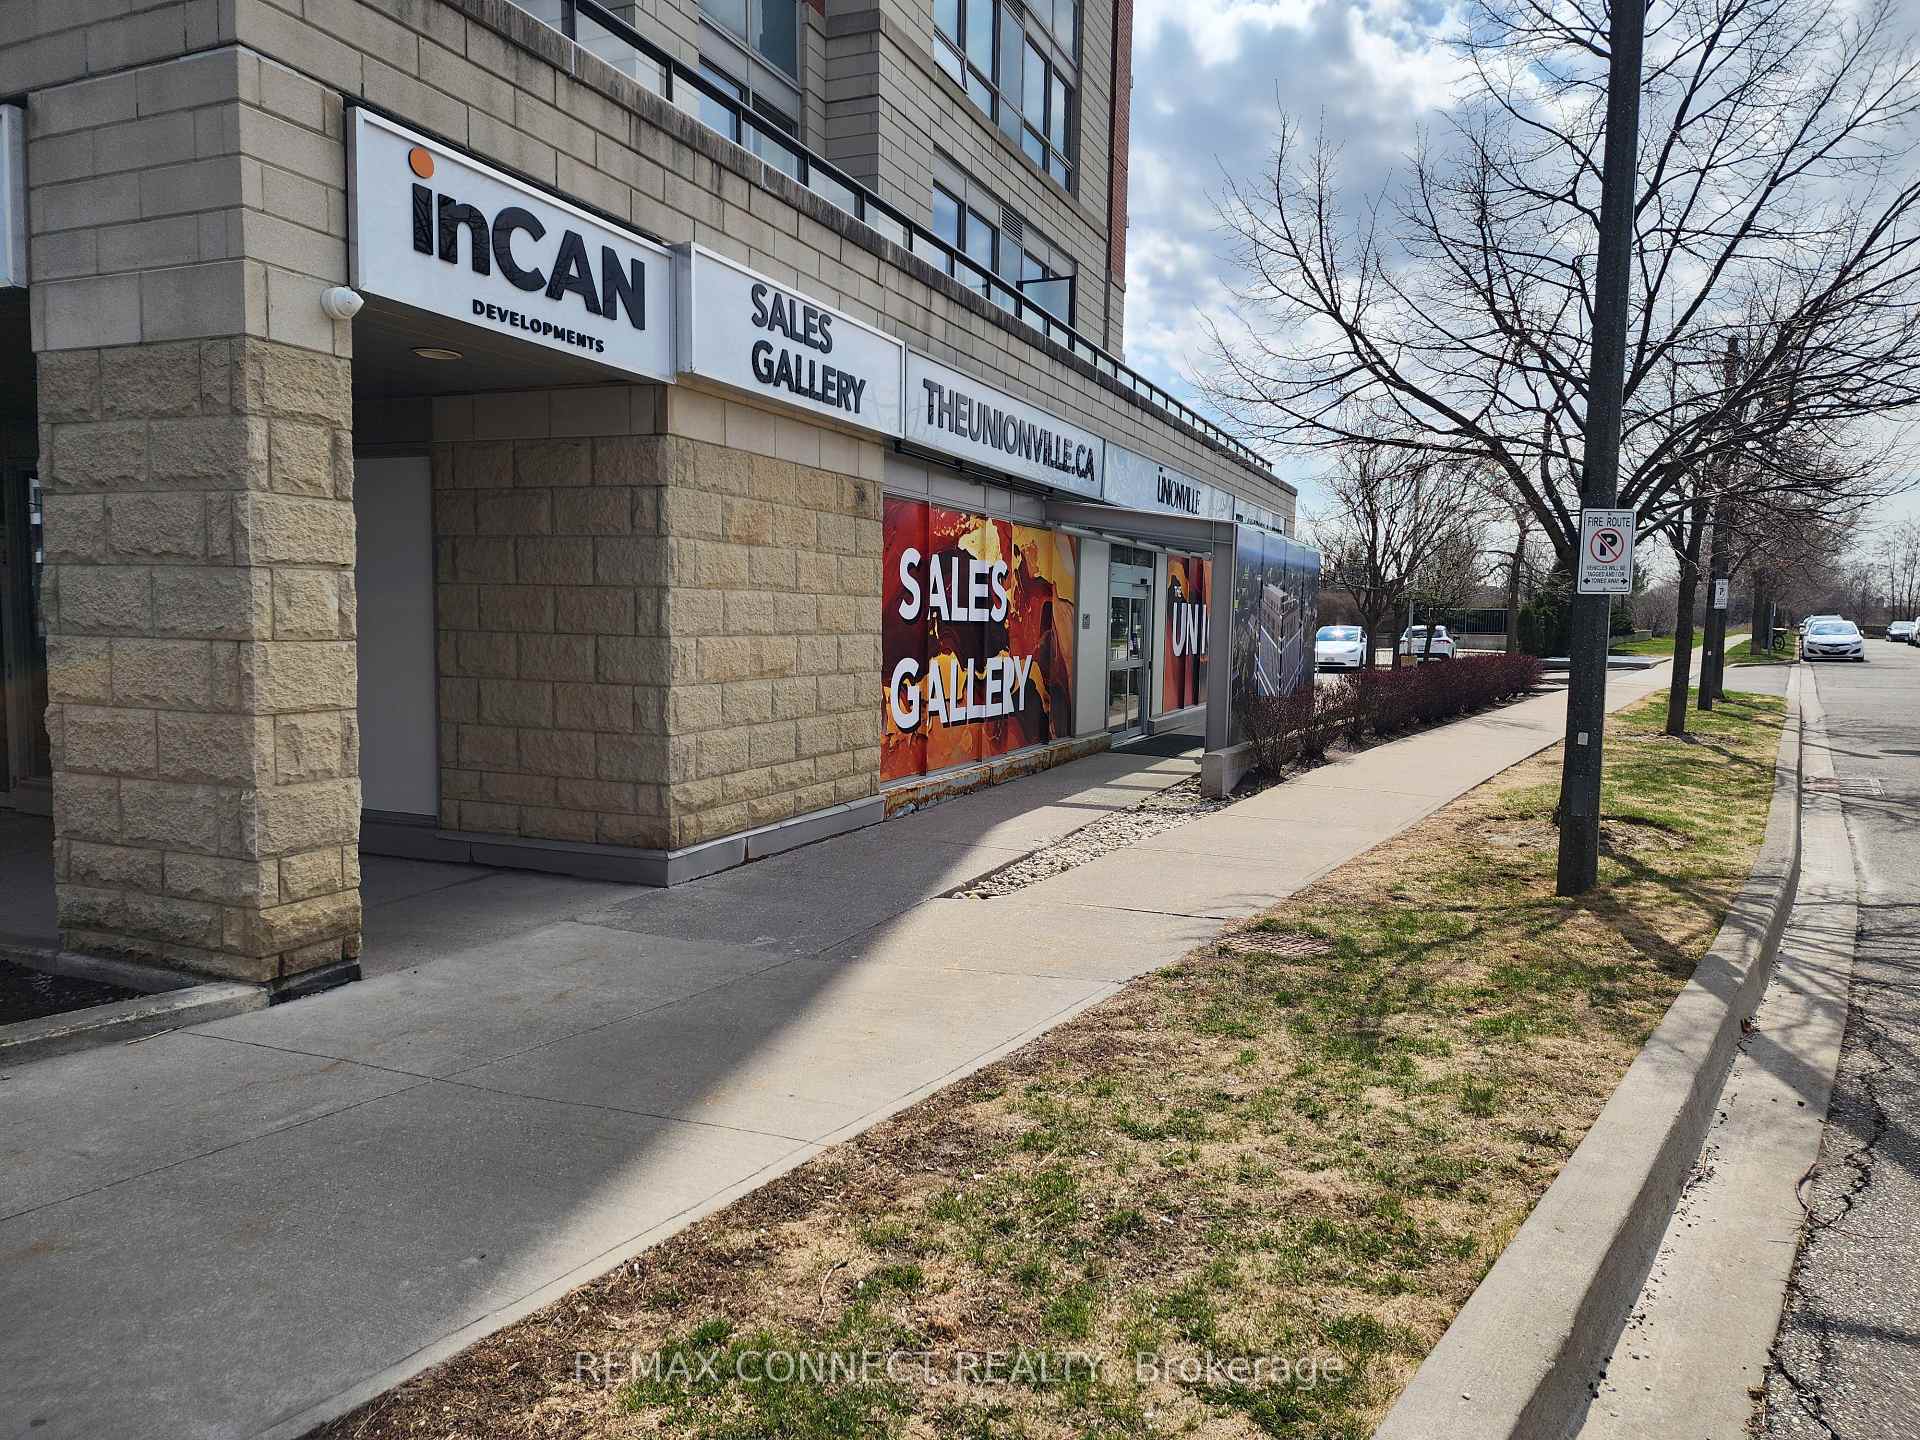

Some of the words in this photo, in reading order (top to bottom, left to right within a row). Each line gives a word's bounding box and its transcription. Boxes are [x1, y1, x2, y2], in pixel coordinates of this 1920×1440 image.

[408, 147, 645, 331] inCAN
[473, 299, 604, 353] DEVELOPMENTS
[751, 283, 833, 354] SALES
[752, 340, 866, 414] GALLERY
[923, 377, 1095, 481] THEUNIONVILLE.CA
[1157, 475, 1201, 514] UNIONVILLE
[1587, 517, 1602, 527] FIRE
[1607, 517, 1631, 527] ROUTE
[899, 547, 1008, 623] SALES
[1172, 602, 1210, 656] UNI
[890, 654, 1033, 729] GALLERY
